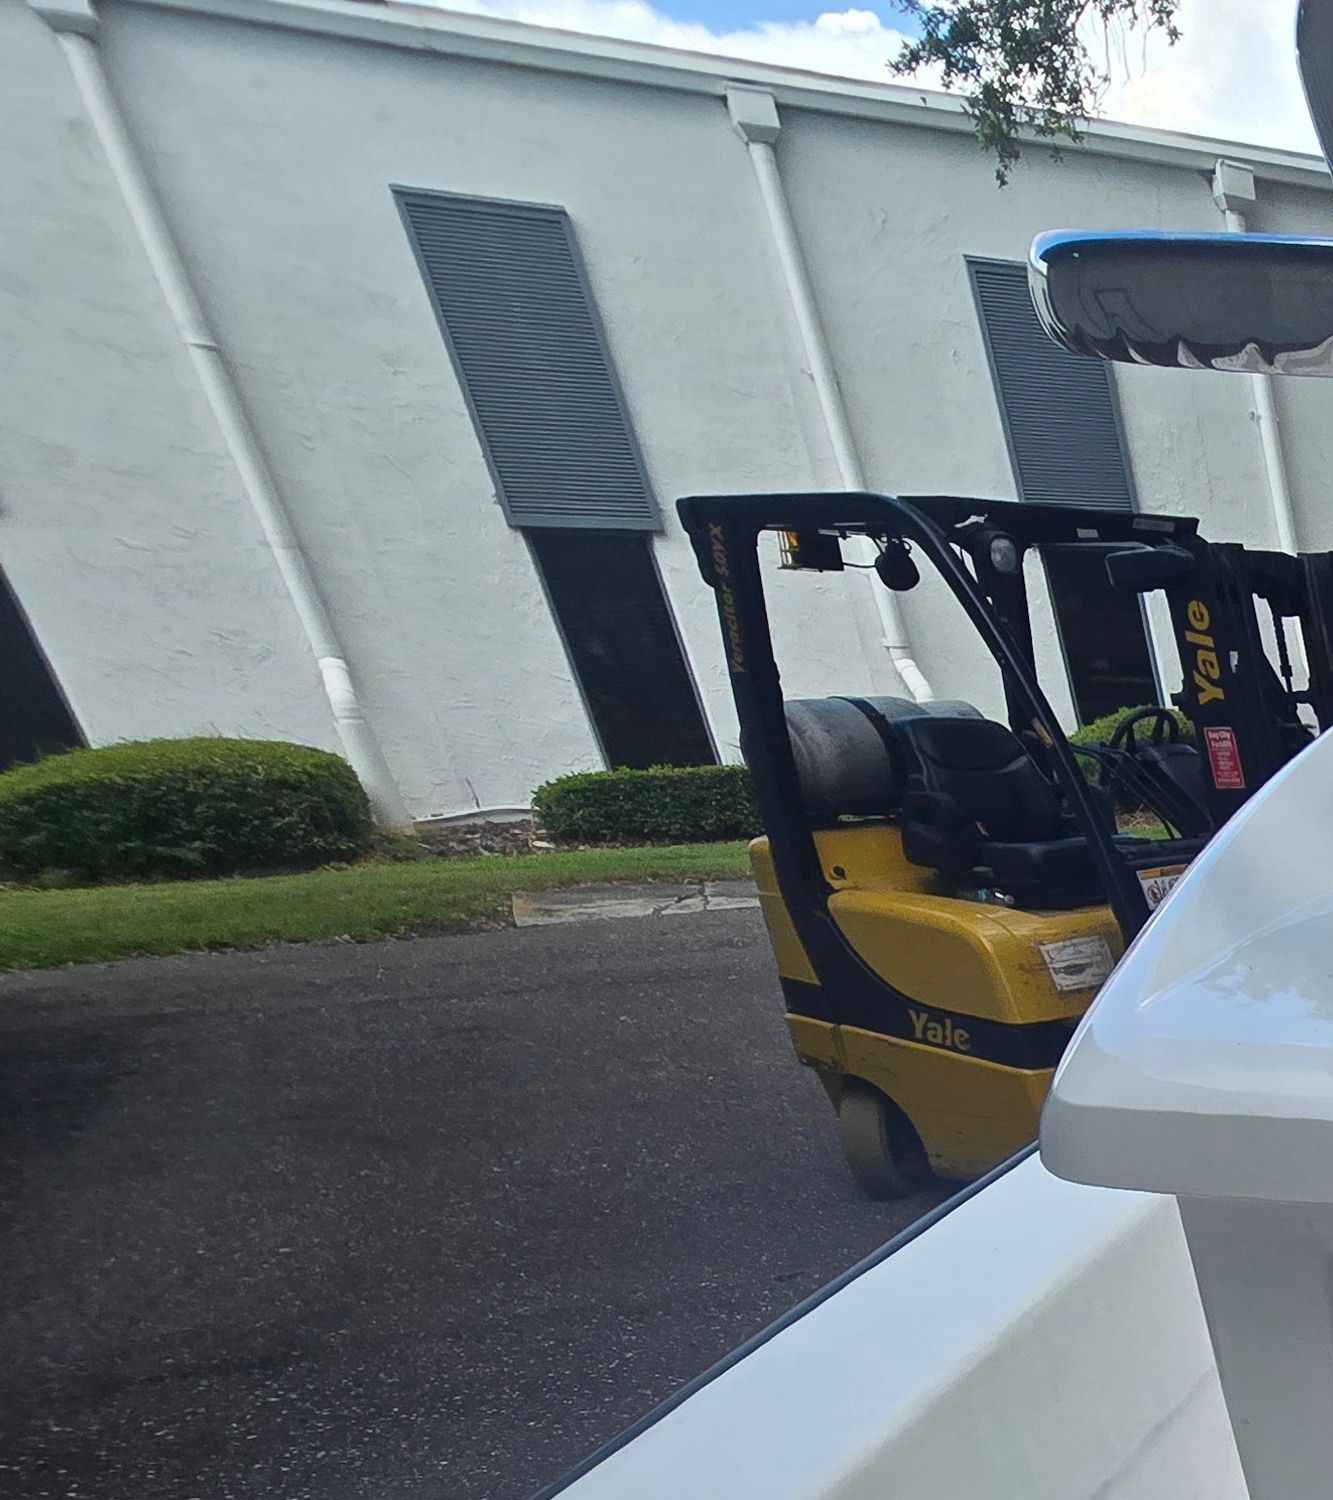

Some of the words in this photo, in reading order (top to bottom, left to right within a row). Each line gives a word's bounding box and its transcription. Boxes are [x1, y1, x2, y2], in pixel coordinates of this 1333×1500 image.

[722, 582, 744, 673] Veracitor
[1184, 600, 1225, 705] Yale
[907, 1009, 971, 1052] Yale
